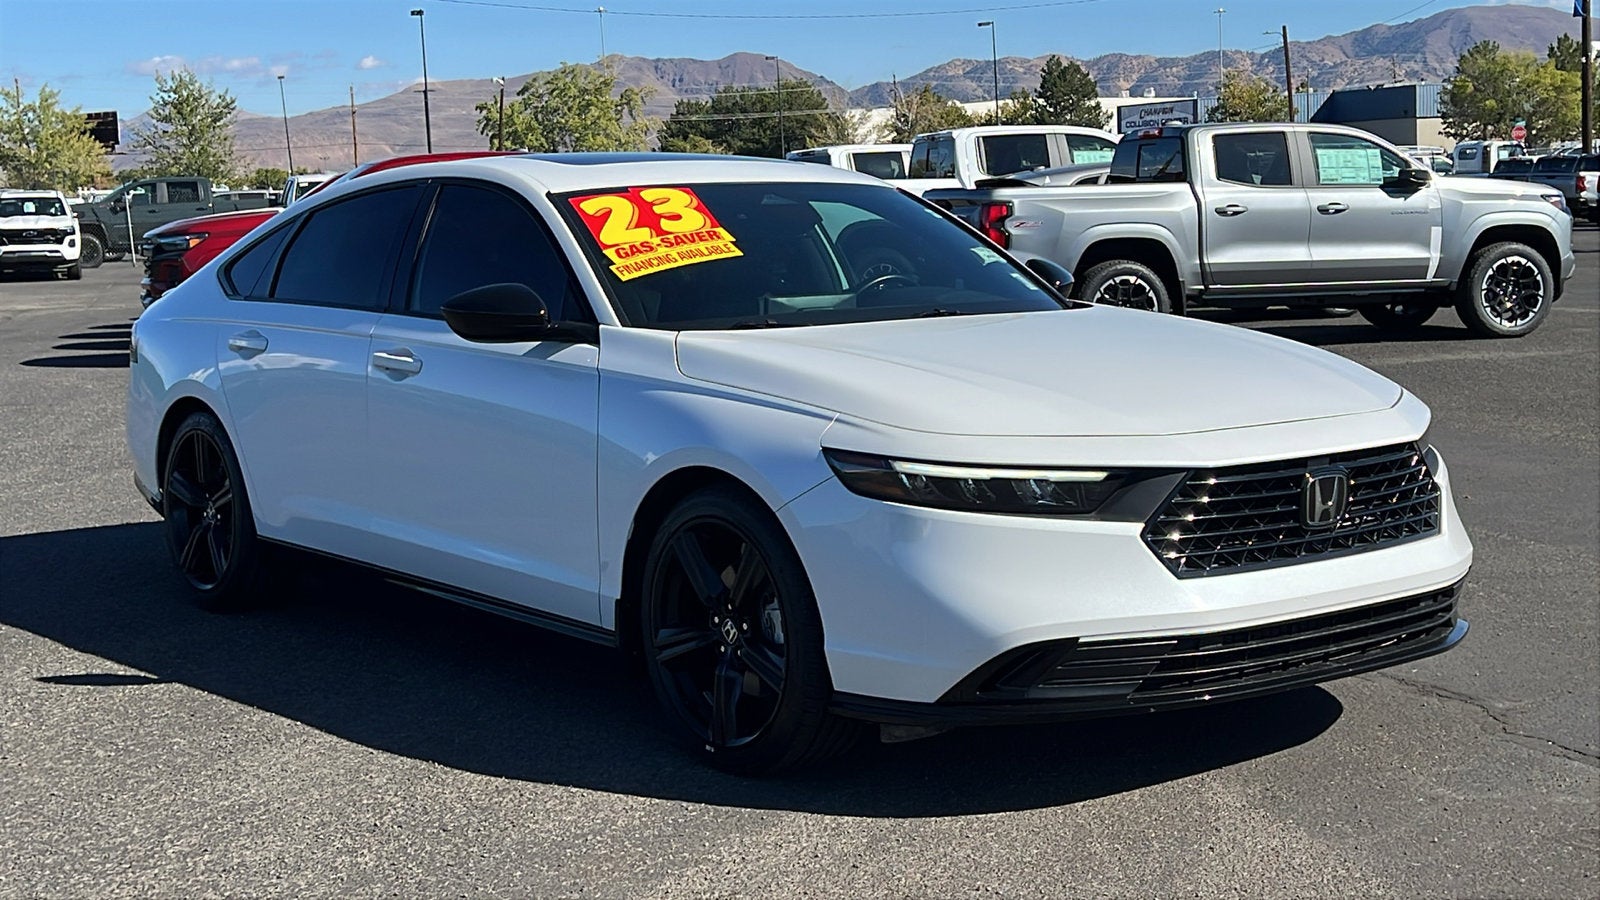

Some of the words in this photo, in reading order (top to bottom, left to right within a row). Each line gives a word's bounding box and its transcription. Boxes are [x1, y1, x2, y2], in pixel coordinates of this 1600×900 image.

[1125, 119, 1159, 128] COLLISION
[579, 188, 711, 245] 23
[615, 230, 721, 259] GAS-SAVER
[615, 253, 678, 277] FINANCING
[679, 243, 736, 262] AVAILABLE
